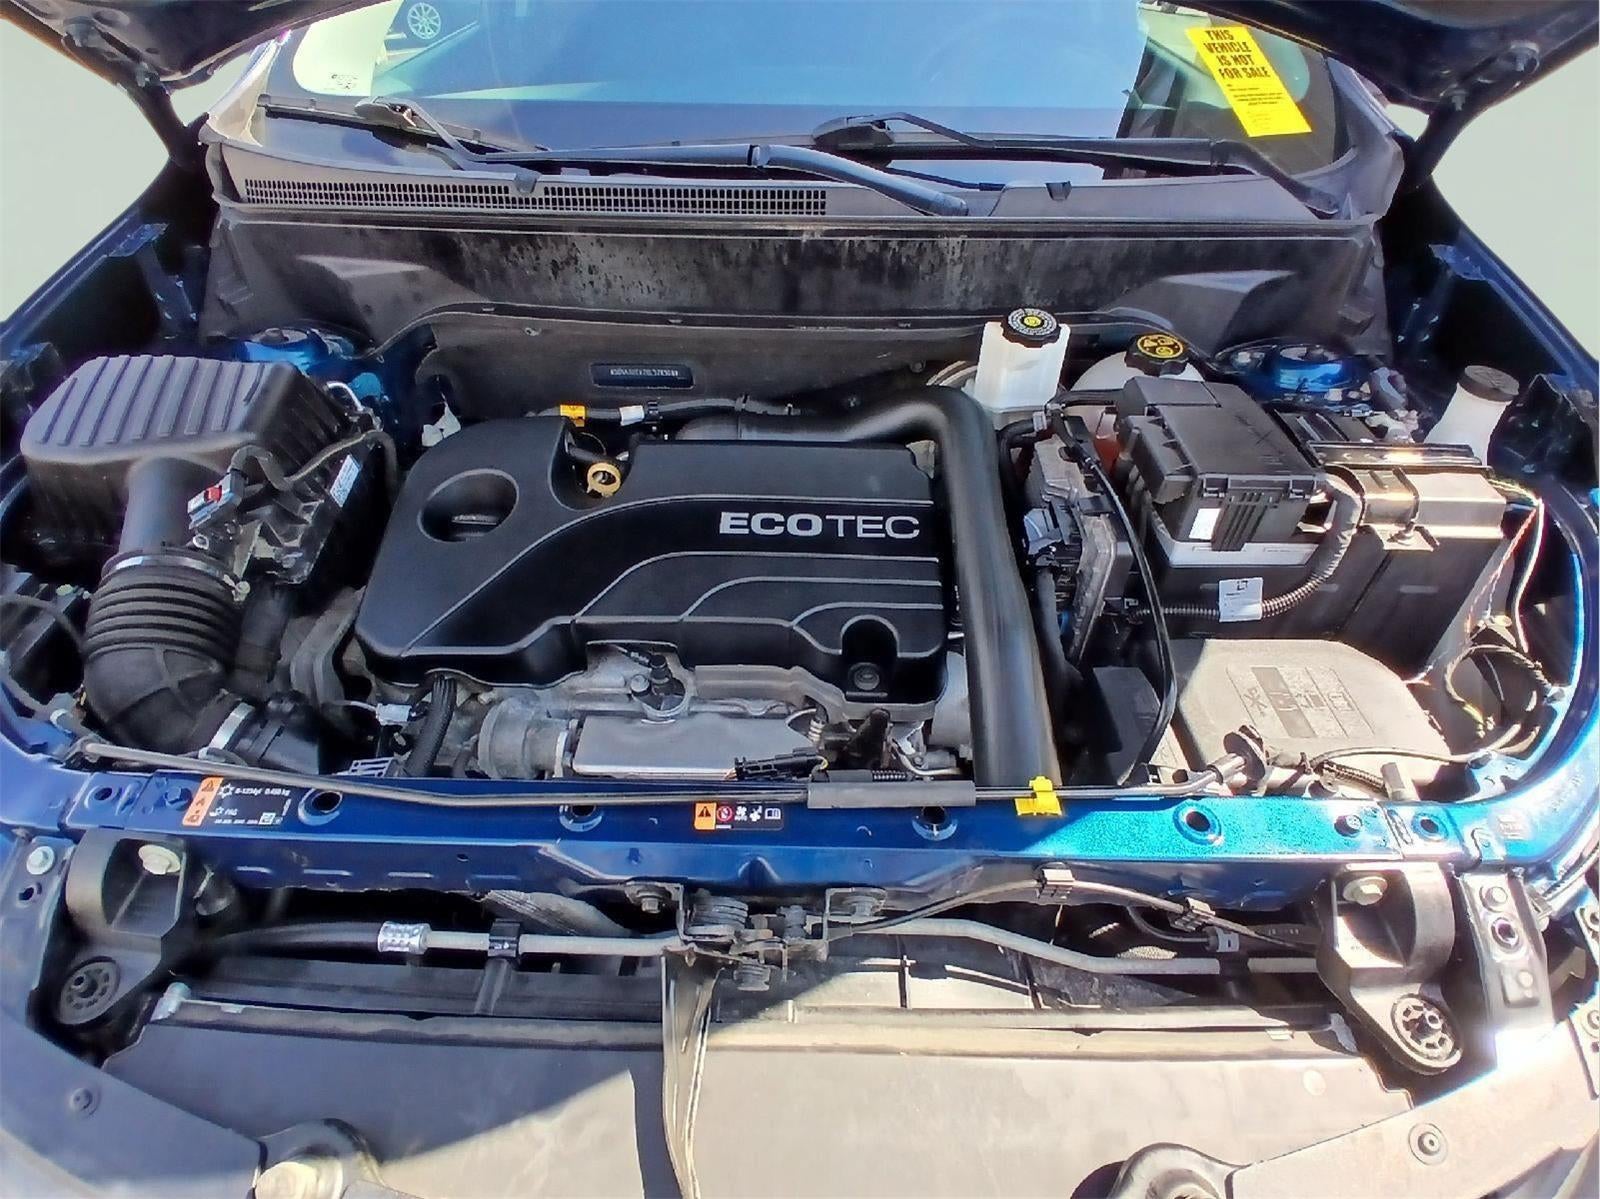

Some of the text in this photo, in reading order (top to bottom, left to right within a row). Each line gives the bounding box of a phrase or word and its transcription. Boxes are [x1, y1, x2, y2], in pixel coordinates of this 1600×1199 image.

[1204, 29, 1234, 41] THIS
[1203, 41, 1252, 53] VEHICLE
[1216, 54, 1255, 66] IS NOT
[1218, 66, 1271, 79] FOR SALE
[719, 511, 920, 539] ECOTEC
